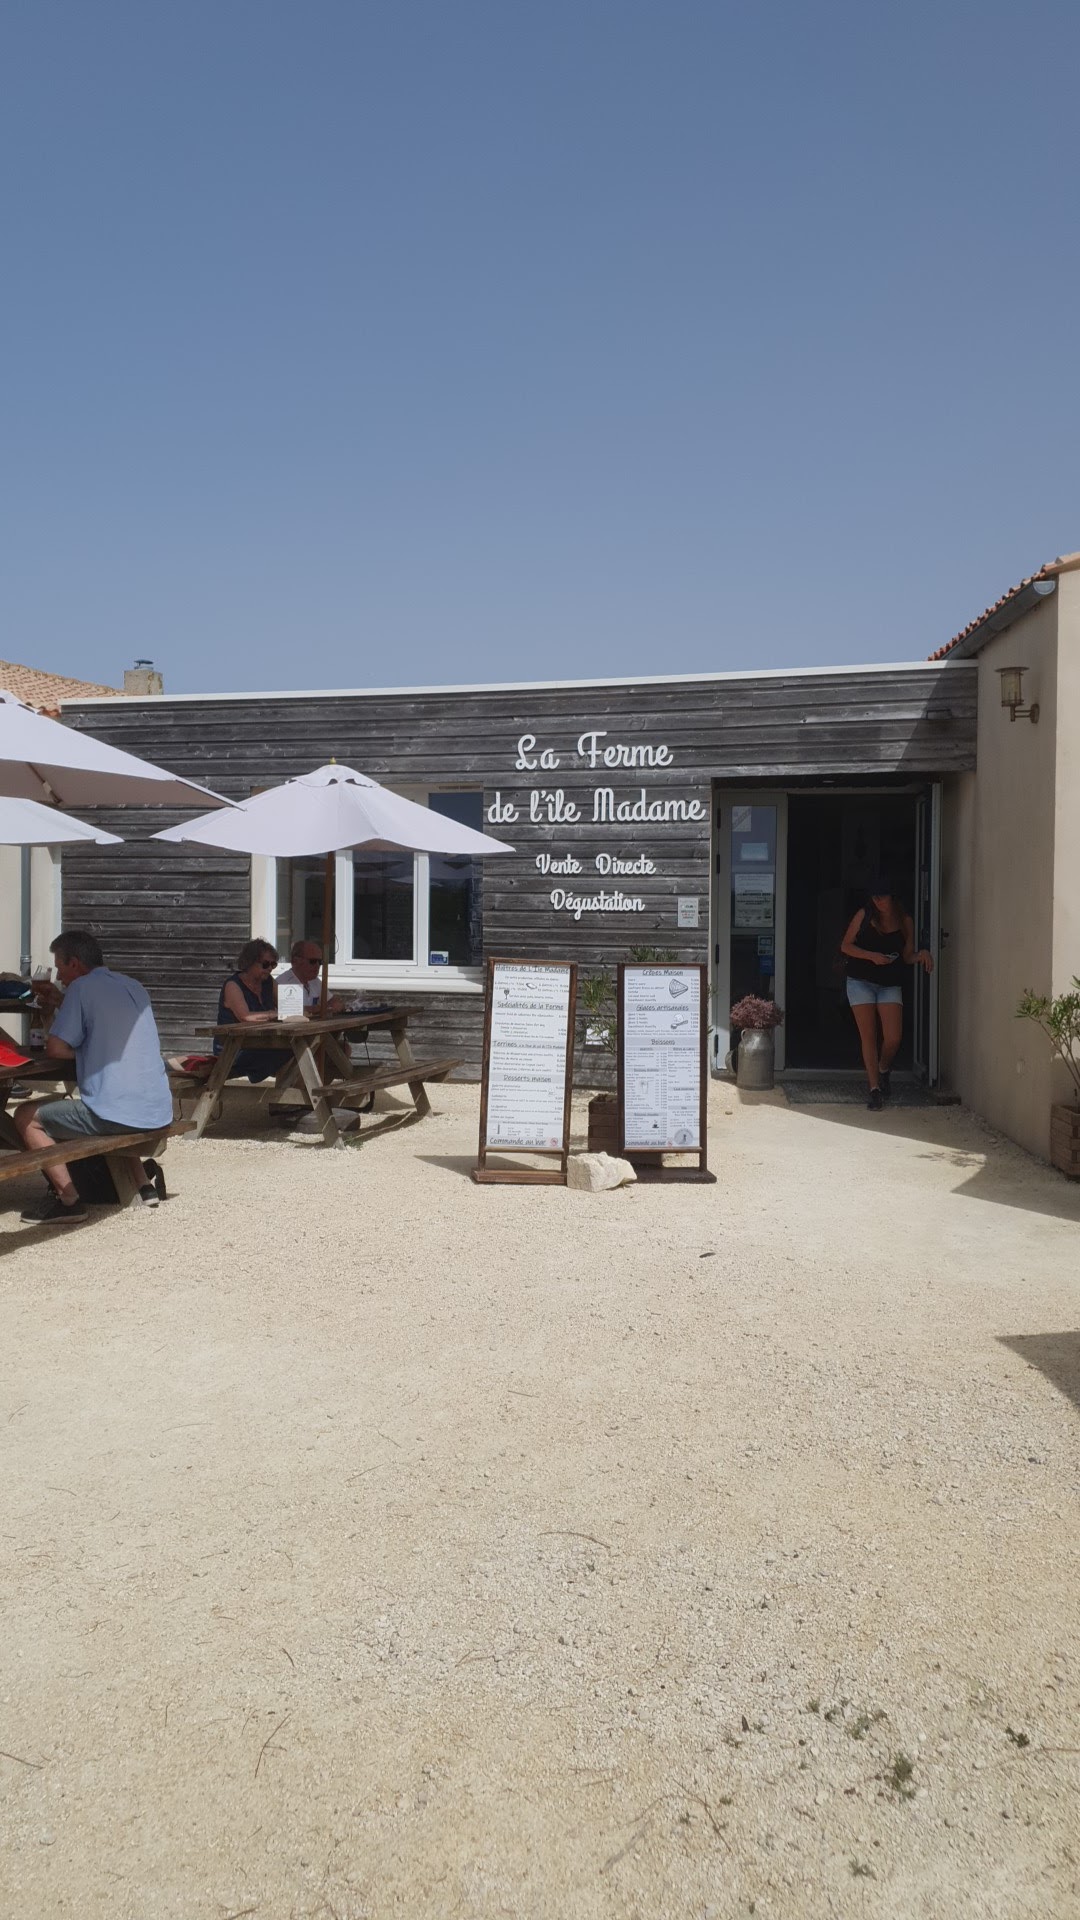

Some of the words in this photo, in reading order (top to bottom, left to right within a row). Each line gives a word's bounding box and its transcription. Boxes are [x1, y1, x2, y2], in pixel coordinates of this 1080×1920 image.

[515, 734, 560, 770] La
[577, 731, 673, 768] Ferme
[487, 791, 519, 823] de
[592, 788, 706, 821] Madame
[535, 854, 582, 875] Vente
[595, 853, 657, 875] Directe
[550, 888, 645, 920] Dégustation
[497, 1001, 529, 1010] Spécialités
[545, 1003, 564, 1011] Ferme
[492, 1040, 517, 1048] Terrines
[503, 1074, 530, 1083] Desserts
